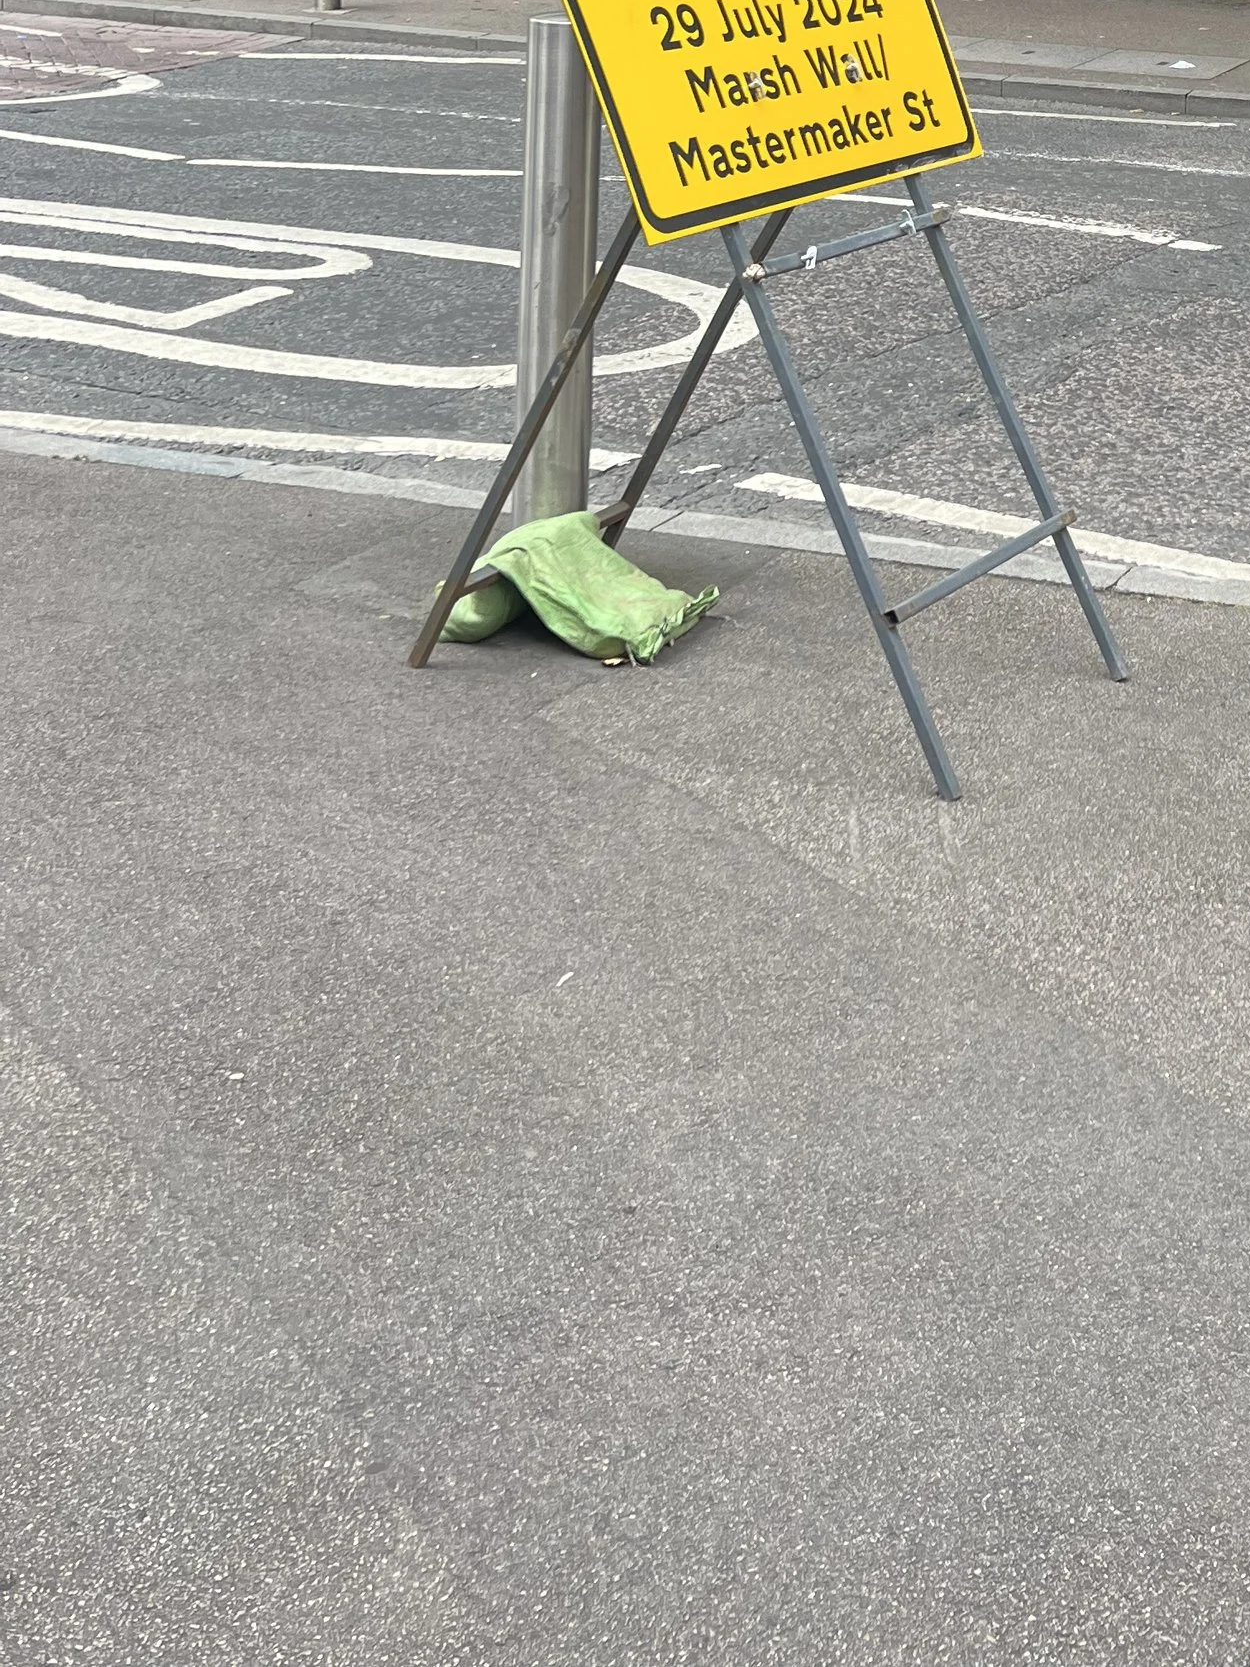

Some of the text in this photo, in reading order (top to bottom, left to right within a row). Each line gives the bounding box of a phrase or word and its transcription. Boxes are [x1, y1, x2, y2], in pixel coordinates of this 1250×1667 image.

[650, 3, 705, 52] 29
[668, 89, 941, 187] Mastermaker St
